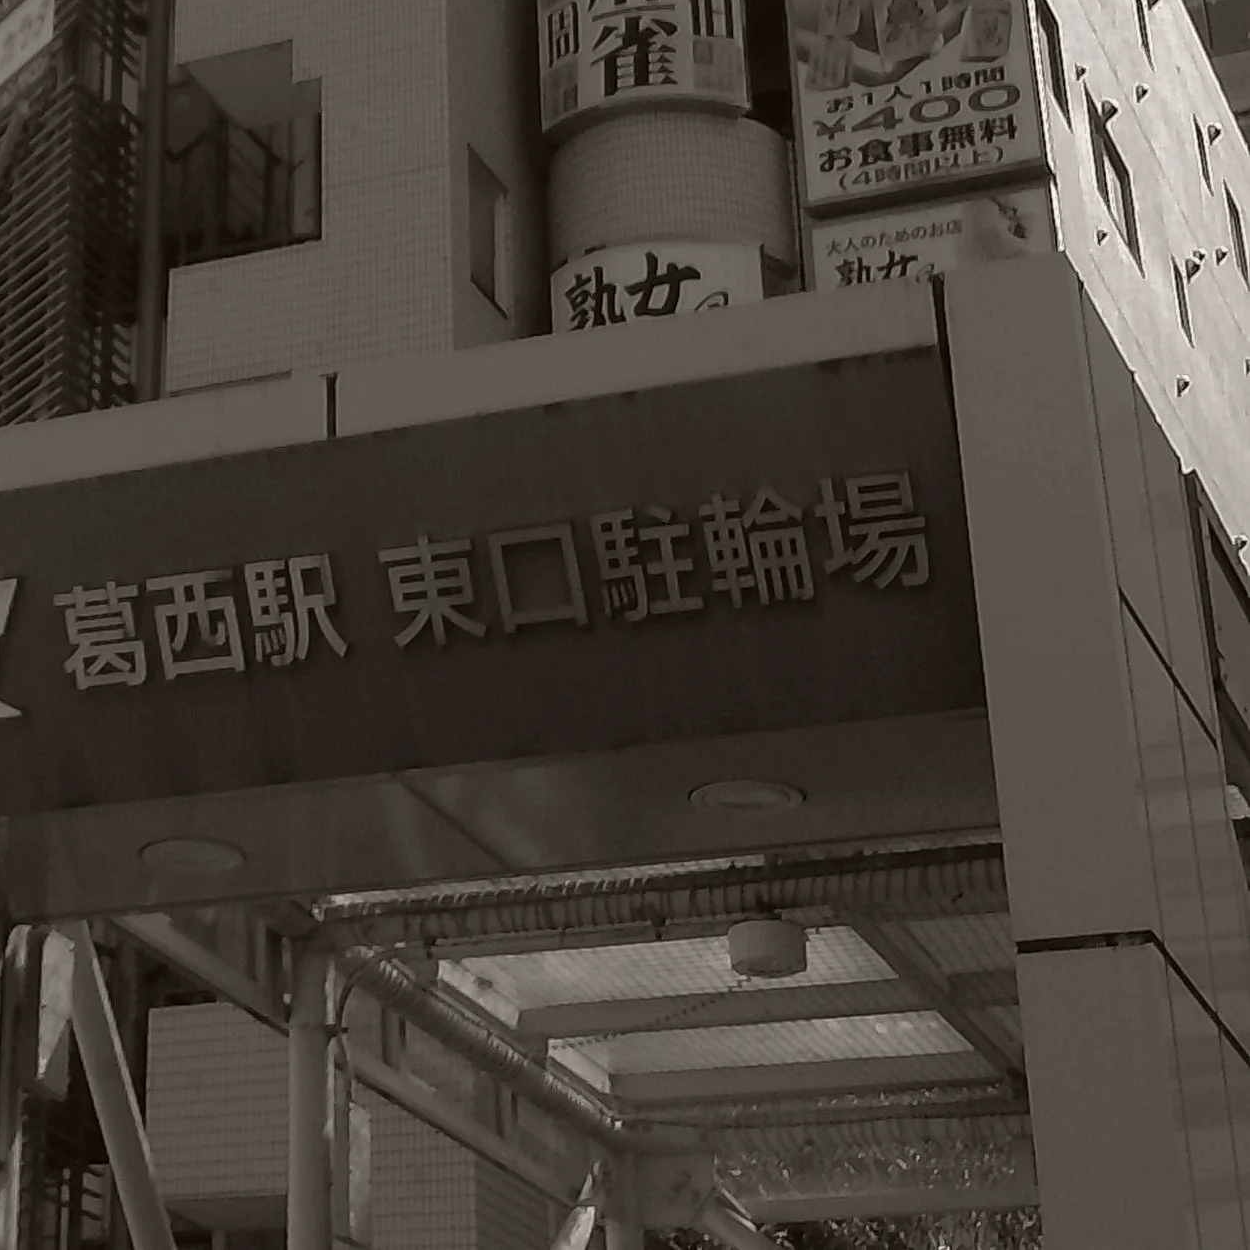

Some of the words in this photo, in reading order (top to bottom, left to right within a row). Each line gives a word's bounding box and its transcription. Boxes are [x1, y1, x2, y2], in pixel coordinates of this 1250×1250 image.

[819, 113, 1018, 173] お食事無料
[53, 552, 349, 692] 葛西駅
[378, 470, 932, 649] 東口駐輪場
